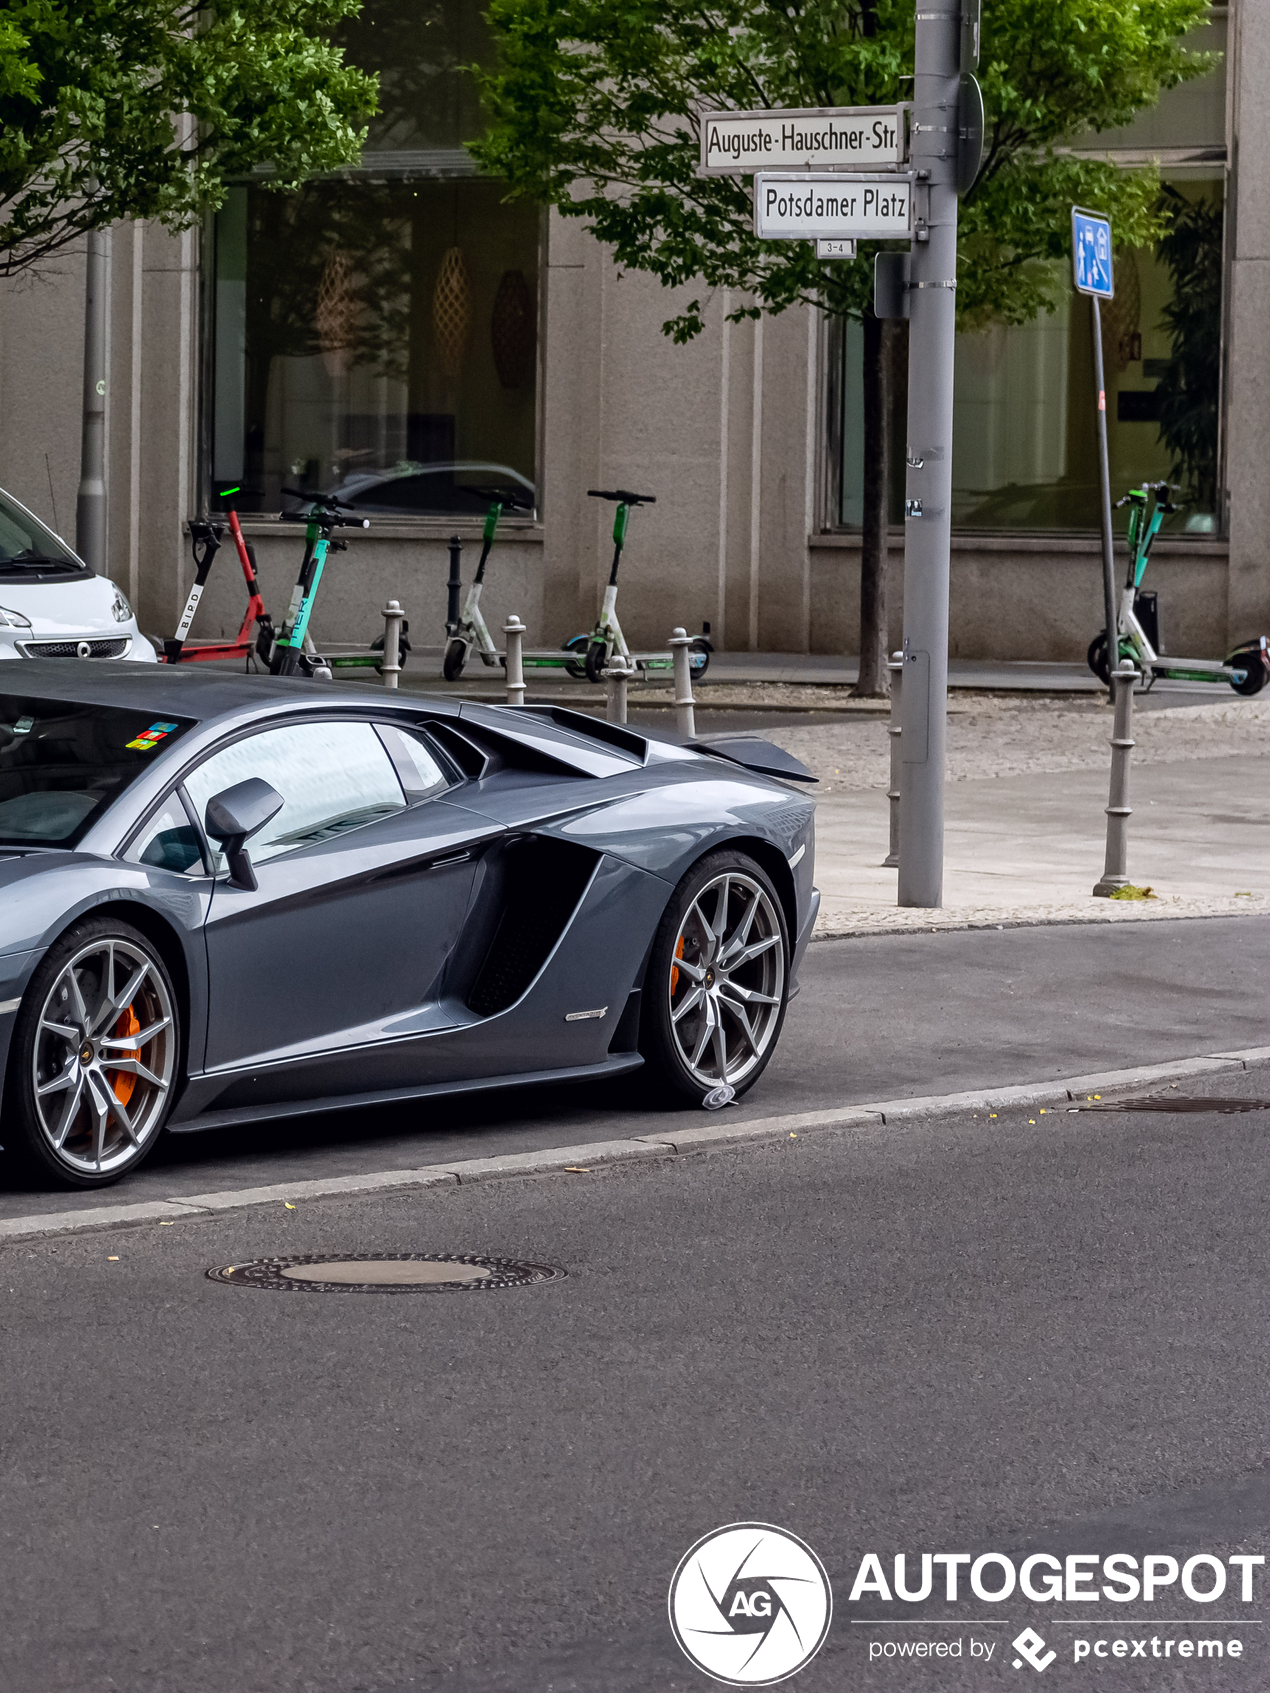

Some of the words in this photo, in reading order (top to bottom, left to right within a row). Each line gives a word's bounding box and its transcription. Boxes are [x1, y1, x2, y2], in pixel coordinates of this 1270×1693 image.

[766, 188, 856, 217] Potsdamer
[863, 189, 906, 217] Platz
[181, 594, 198, 628] BIRD
